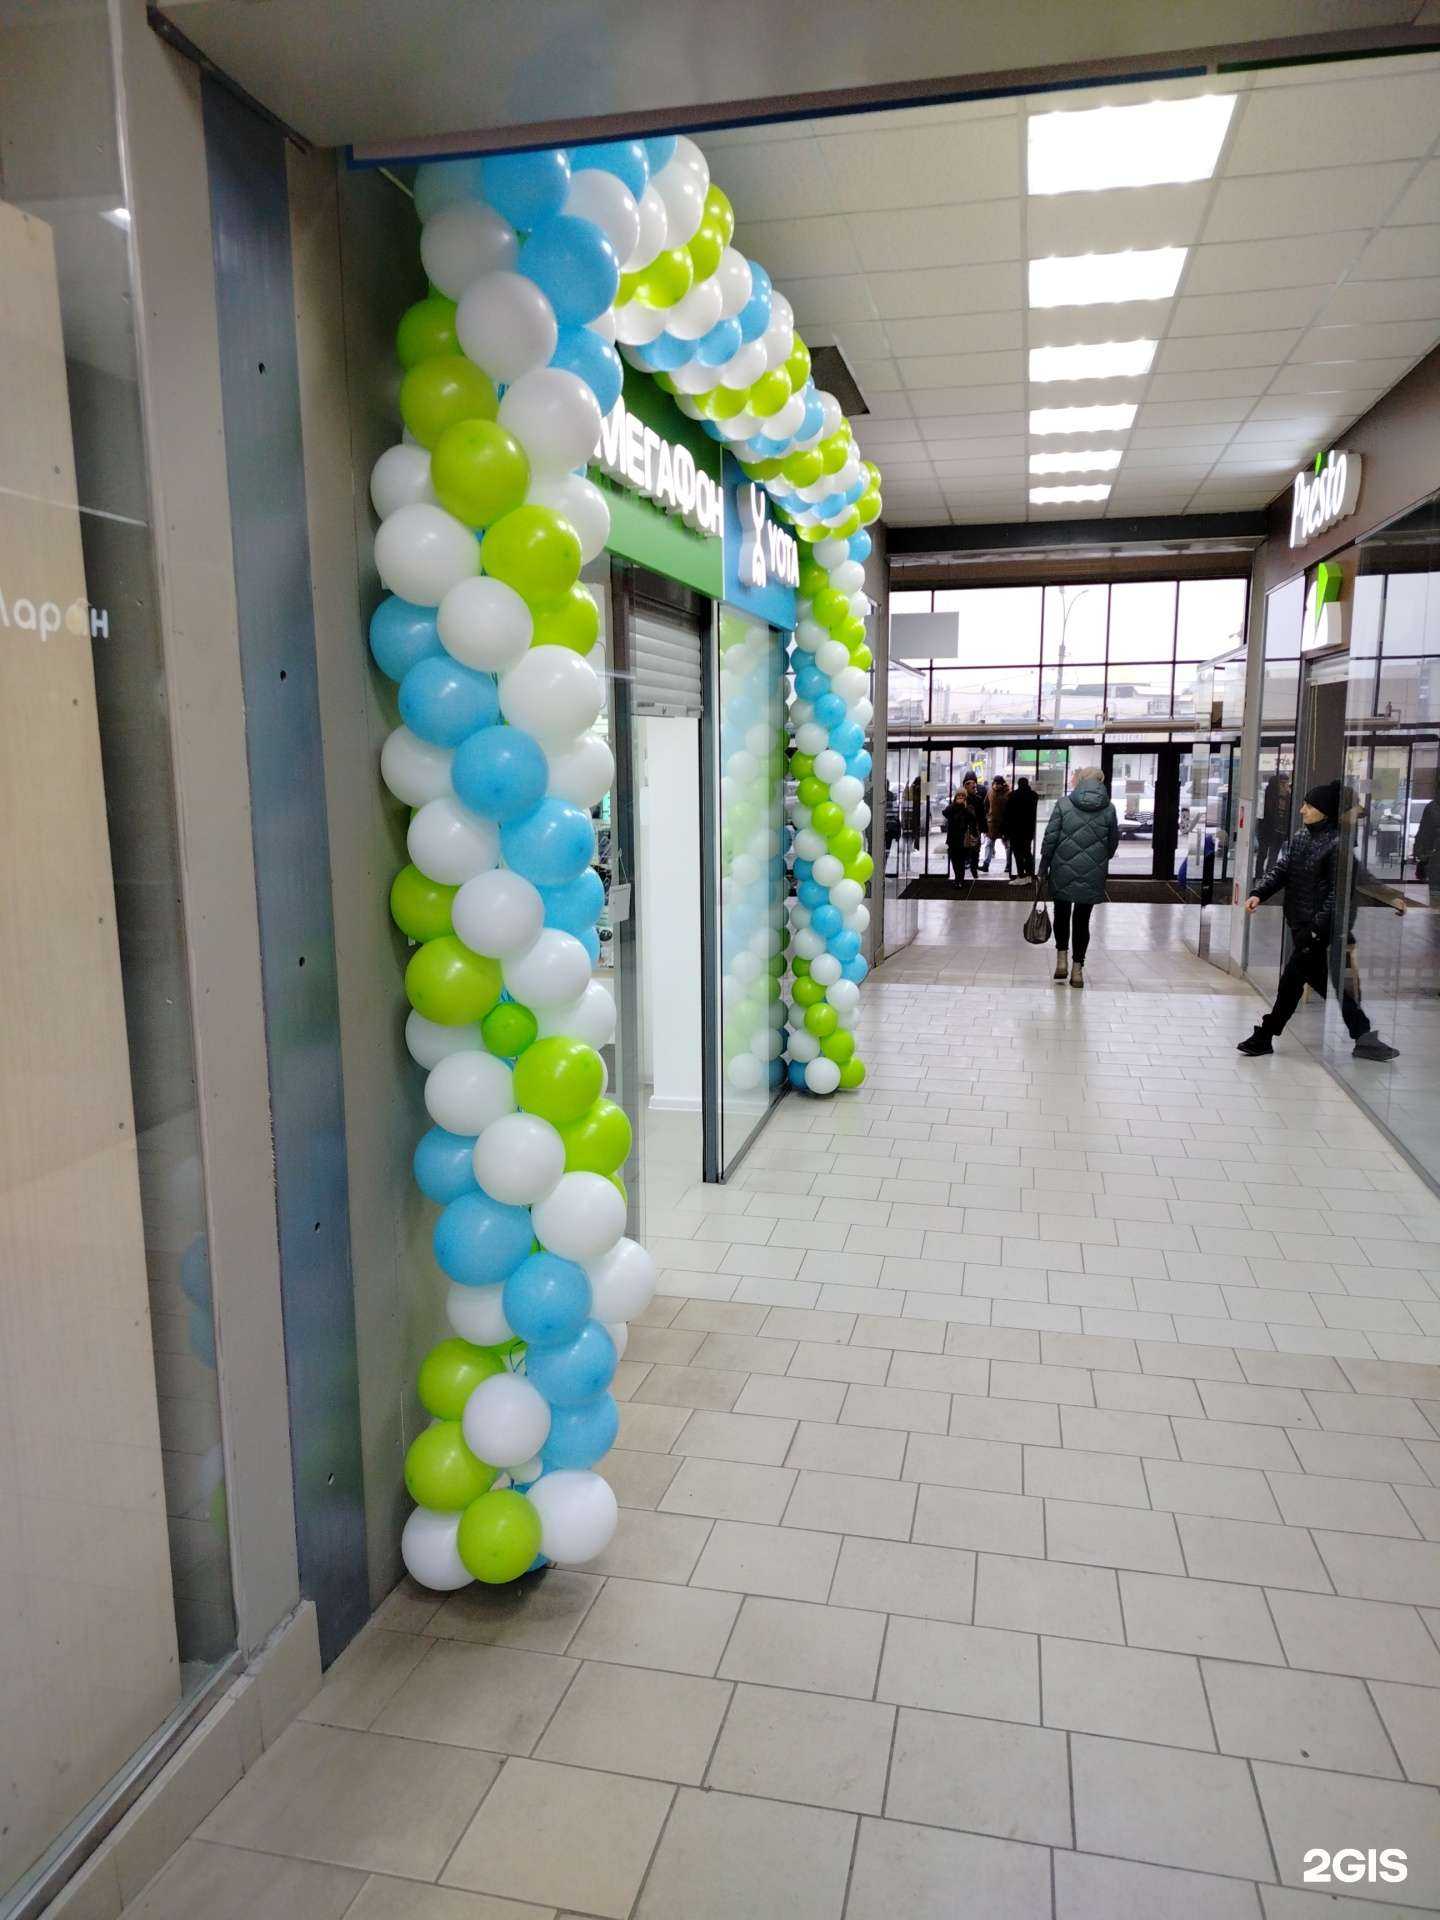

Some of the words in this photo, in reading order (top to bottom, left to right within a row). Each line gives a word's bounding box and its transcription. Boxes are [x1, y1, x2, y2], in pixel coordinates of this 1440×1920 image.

[594, 395, 724, 539] МЕГАФОН
[1289, 449, 1348, 549] Presto
[767, 518, 800, 588] YOTA
